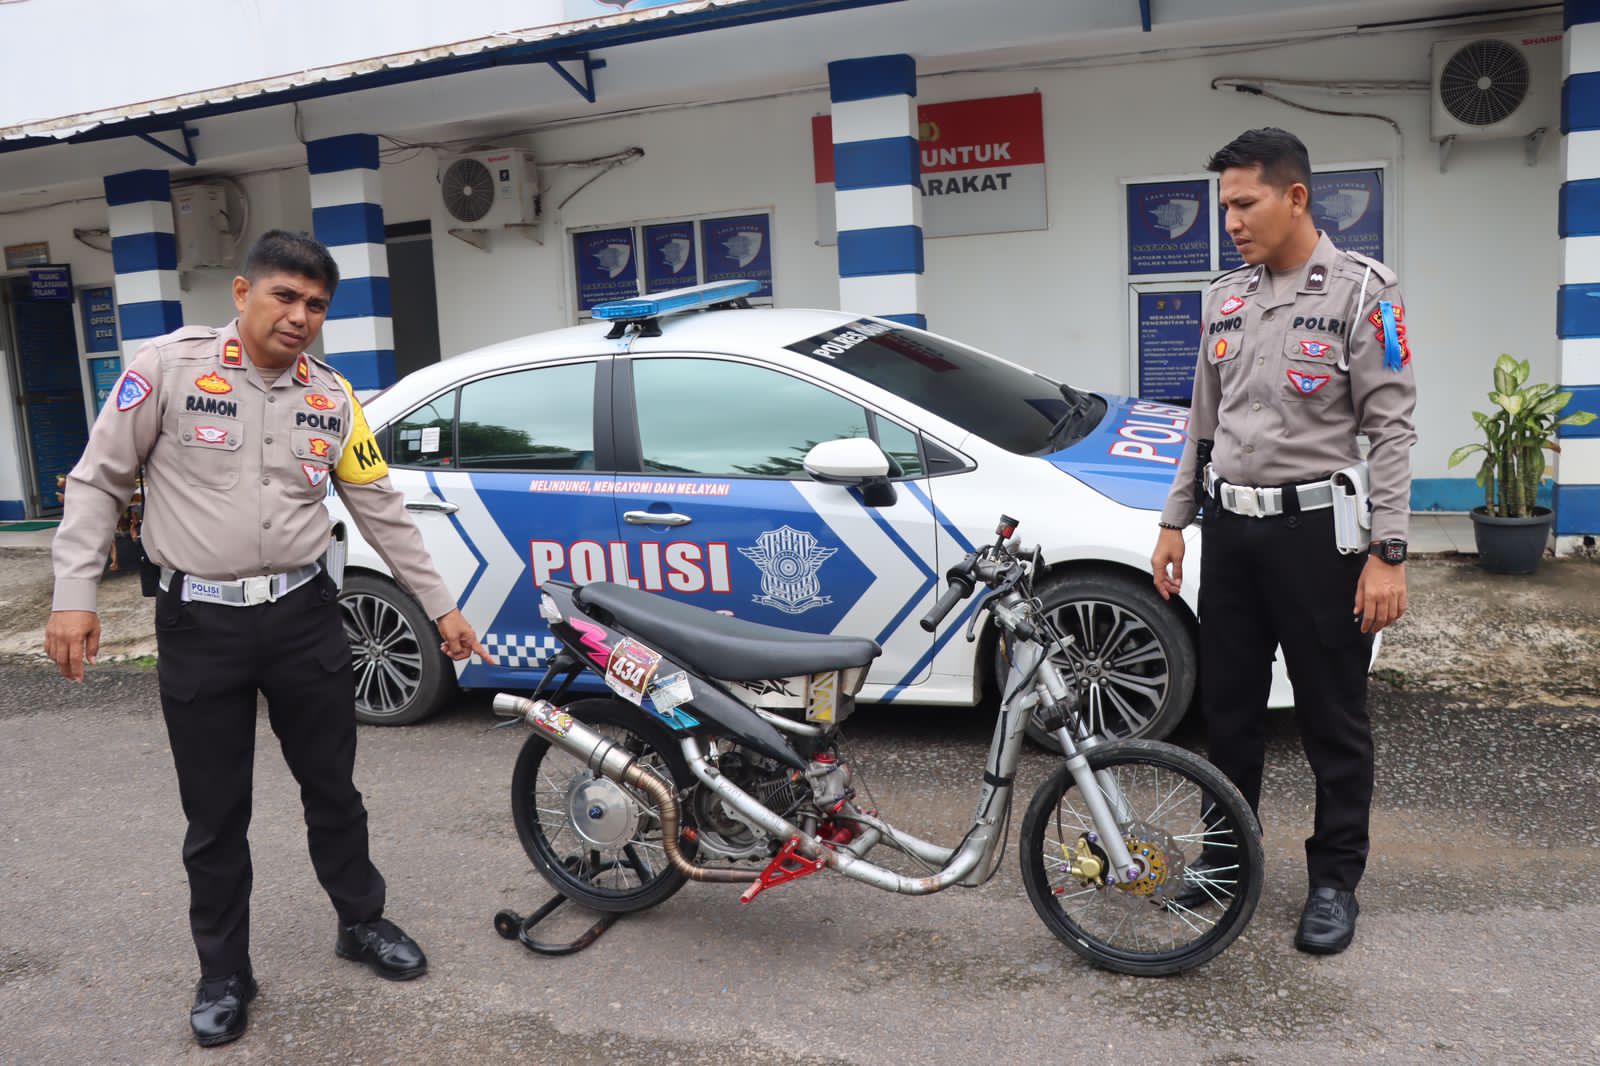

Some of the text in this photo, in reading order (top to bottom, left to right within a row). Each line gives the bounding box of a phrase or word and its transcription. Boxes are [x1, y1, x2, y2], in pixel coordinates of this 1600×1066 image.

[1521, 34, 1564, 46] SHARP
[921, 142, 1012, 168] UNTUK
[90, 316, 116, 325] OFFICE
[1209, 317, 1242, 335] BOWO
[1293, 316, 1346, 335] POLRI
[812, 331, 869, 359] POLRES
[186, 395, 237, 418] RAMON
[296, 412, 340, 433] POLRI
[528, 479, 731, 497] MELINDUNGI, MENGAYOMI DAN MELAYANI
[529, 539, 733, 594] POLISI
[191, 583, 220, 595] POLISI
[612, 656, 647, 687] 434
